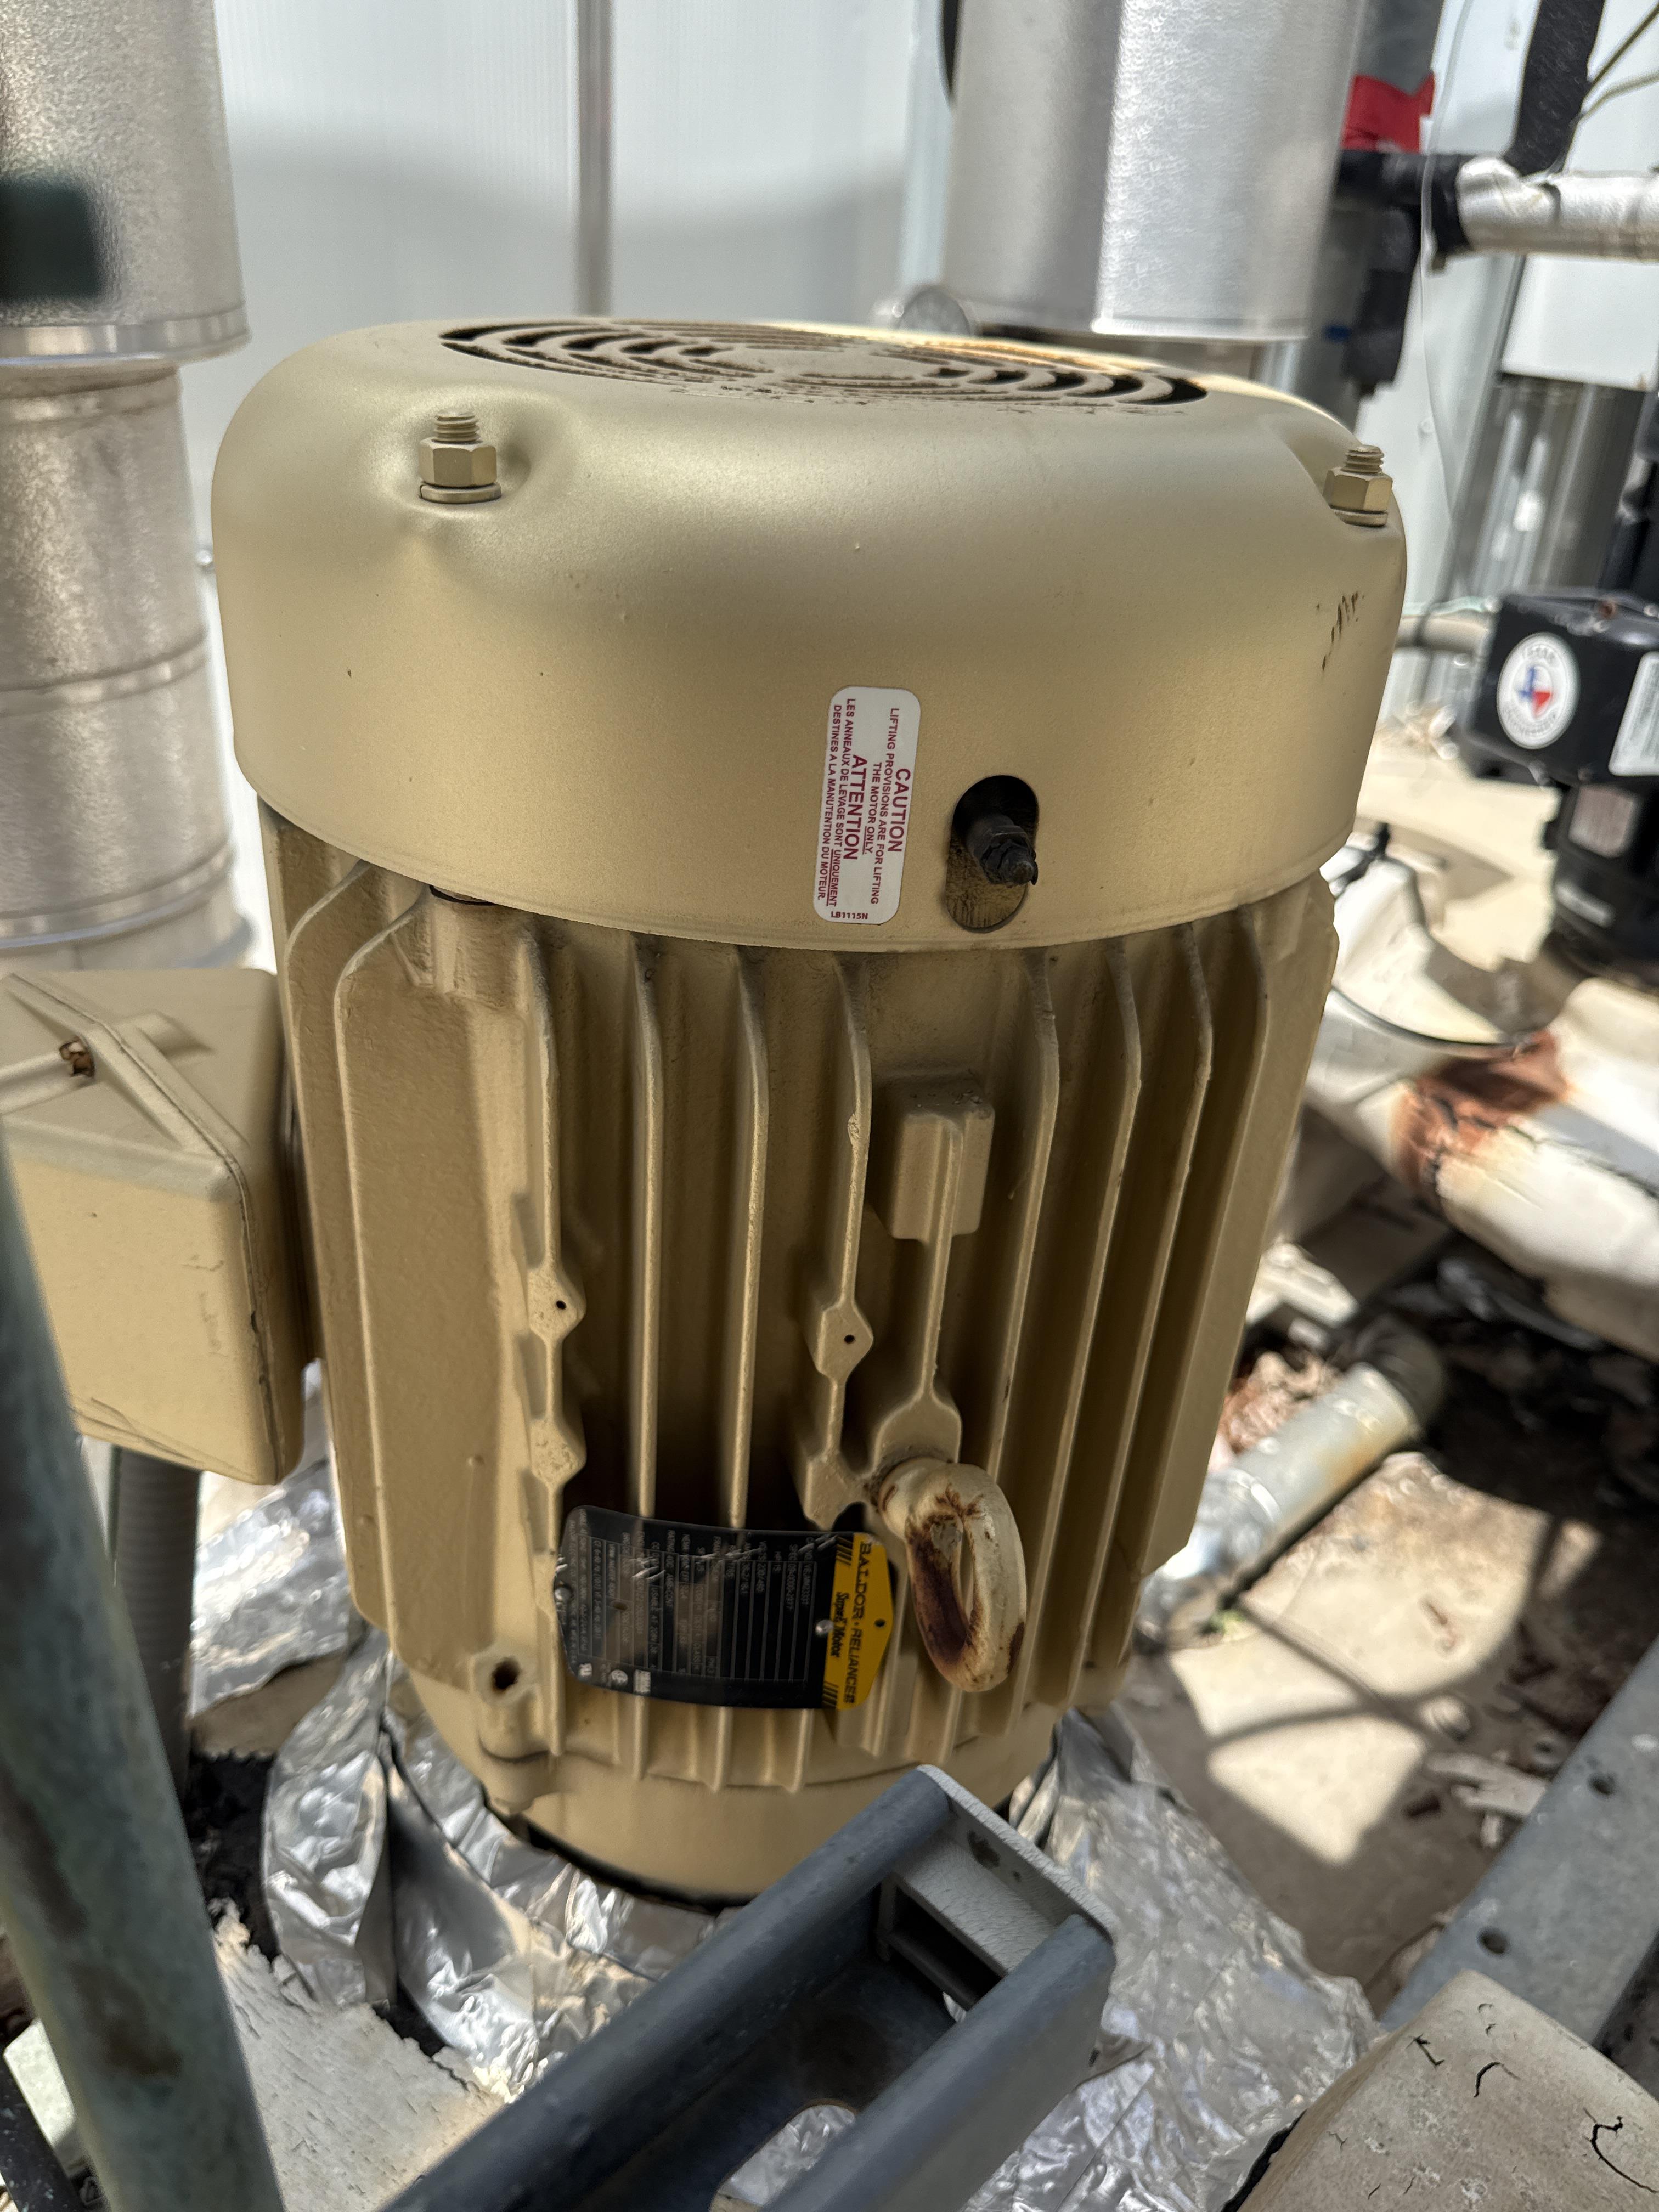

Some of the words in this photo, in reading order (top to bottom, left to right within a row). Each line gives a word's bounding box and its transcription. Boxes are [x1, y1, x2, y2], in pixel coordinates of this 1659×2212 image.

[846, 699, 855, 717] LES
[831, 705, 842, 752] DESTINES
[842, 720, 853, 766] ANNEAUX
[887, 708, 899, 749] LIFTING
[828, 764, 836, 775] LA
[840, 769, 849, 781] DE
[872, 762, 882, 782] THE
[880, 753, 894, 817] PROVISIONS
[822, 779, 835, 844] MANUTENTION
[837, 785, 847, 820] LEVAGE
[843, 754, 867, 859] ATTENTION
[868, 786, 878, 823] MOTOR
[888, 769, 911, 852] CAUTION
[834, 823, 844, 847] SONT
[865, 826, 874, 854] ONLY.
[877, 820, 887, 840] ARE
[822, 847, 830, 859] DU
[875, 844, 884, 864] FOR
[818, 862, 828, 900] MOTEUR.
[830, 850, 841, 907] UNIQUEMENT
[871, 867, 882, 904] LIFTING
[831, 911, 868, 919] LB1115N
[854, 1542, 871, 1620] BALDOR
[831, 1626, 847, 1657] Motor
